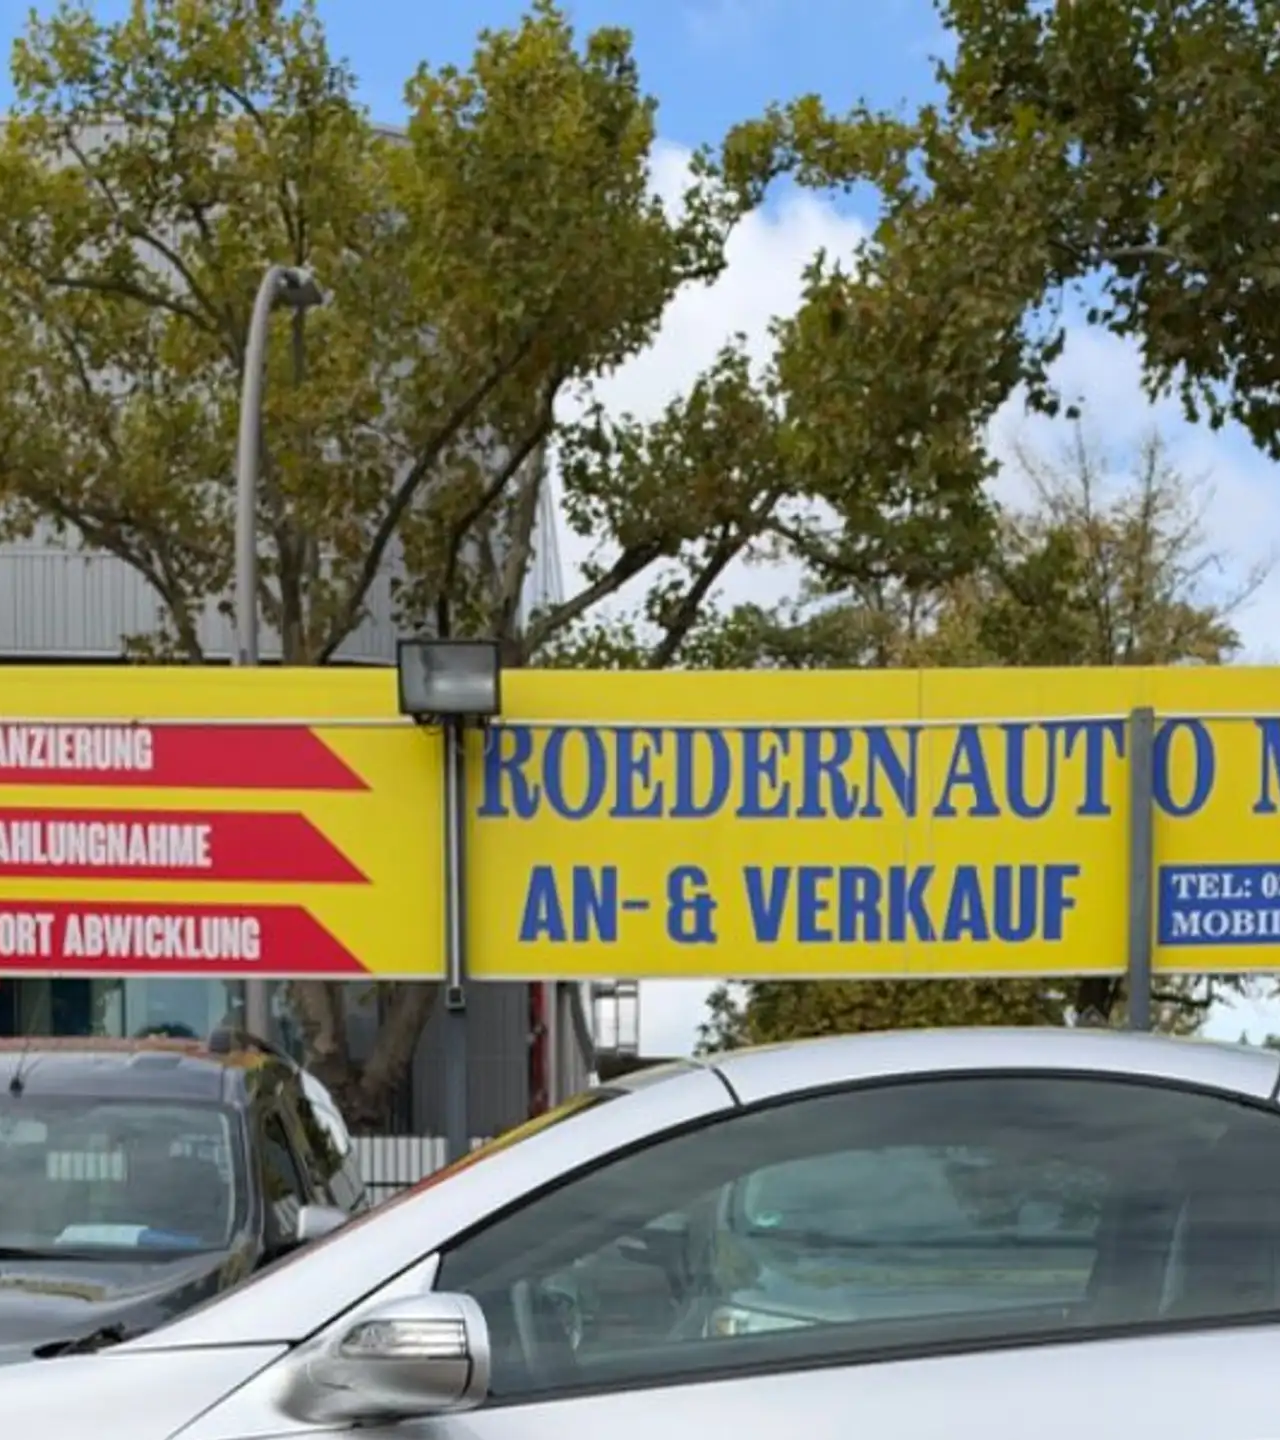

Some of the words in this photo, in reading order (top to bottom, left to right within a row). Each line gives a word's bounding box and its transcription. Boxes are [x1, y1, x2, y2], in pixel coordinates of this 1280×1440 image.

[666, 865, 717, 944] &
[744, 864, 1081, 942] VERKAUF
[1171, 872, 1252, 899] TEL:
[63, 914, 261, 961] ABWICKLUNG
